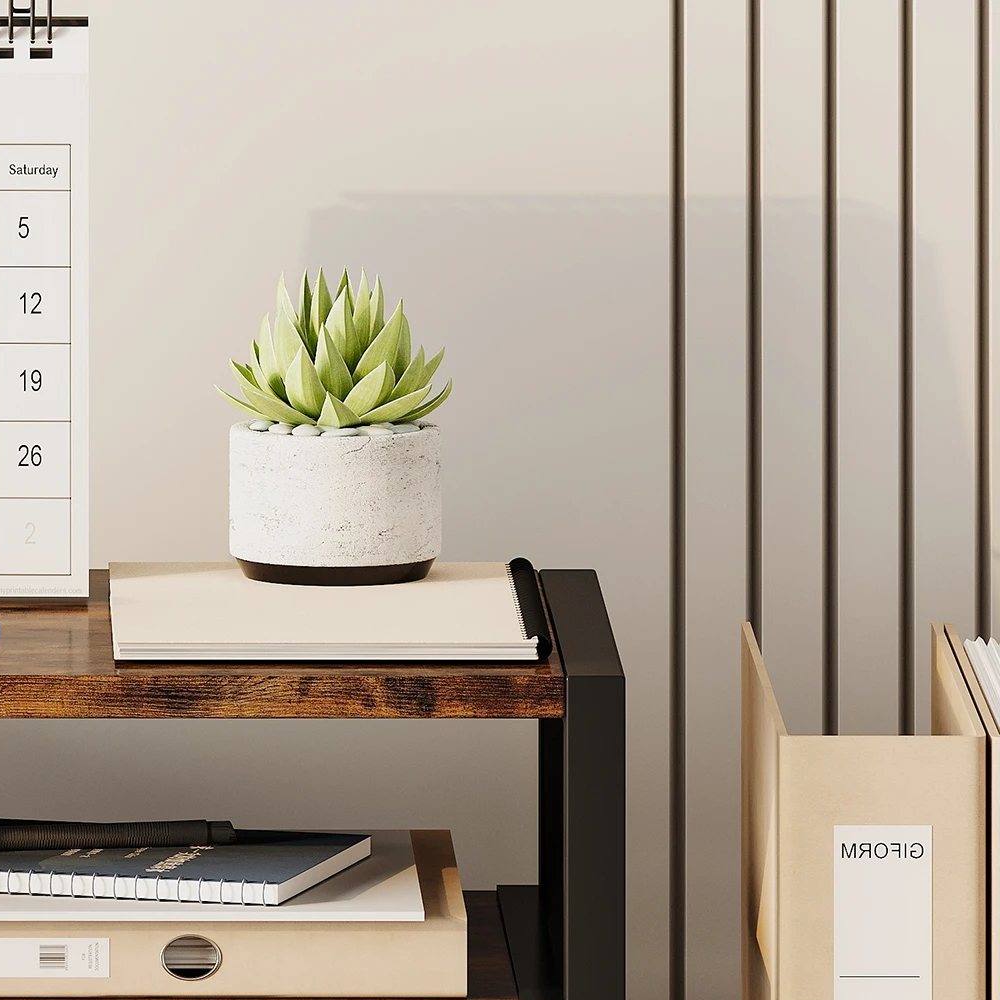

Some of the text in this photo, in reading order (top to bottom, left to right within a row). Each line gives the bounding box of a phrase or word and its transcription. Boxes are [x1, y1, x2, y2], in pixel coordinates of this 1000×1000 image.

[8, 163, 59, 179] Saturday
[18, 216, 30, 239] 5
[19, 291, 43, 315] 12
[19, 369, 43, 392] 19
[17, 444, 43, 467] 26
[24, 521, 36, 545] 2
